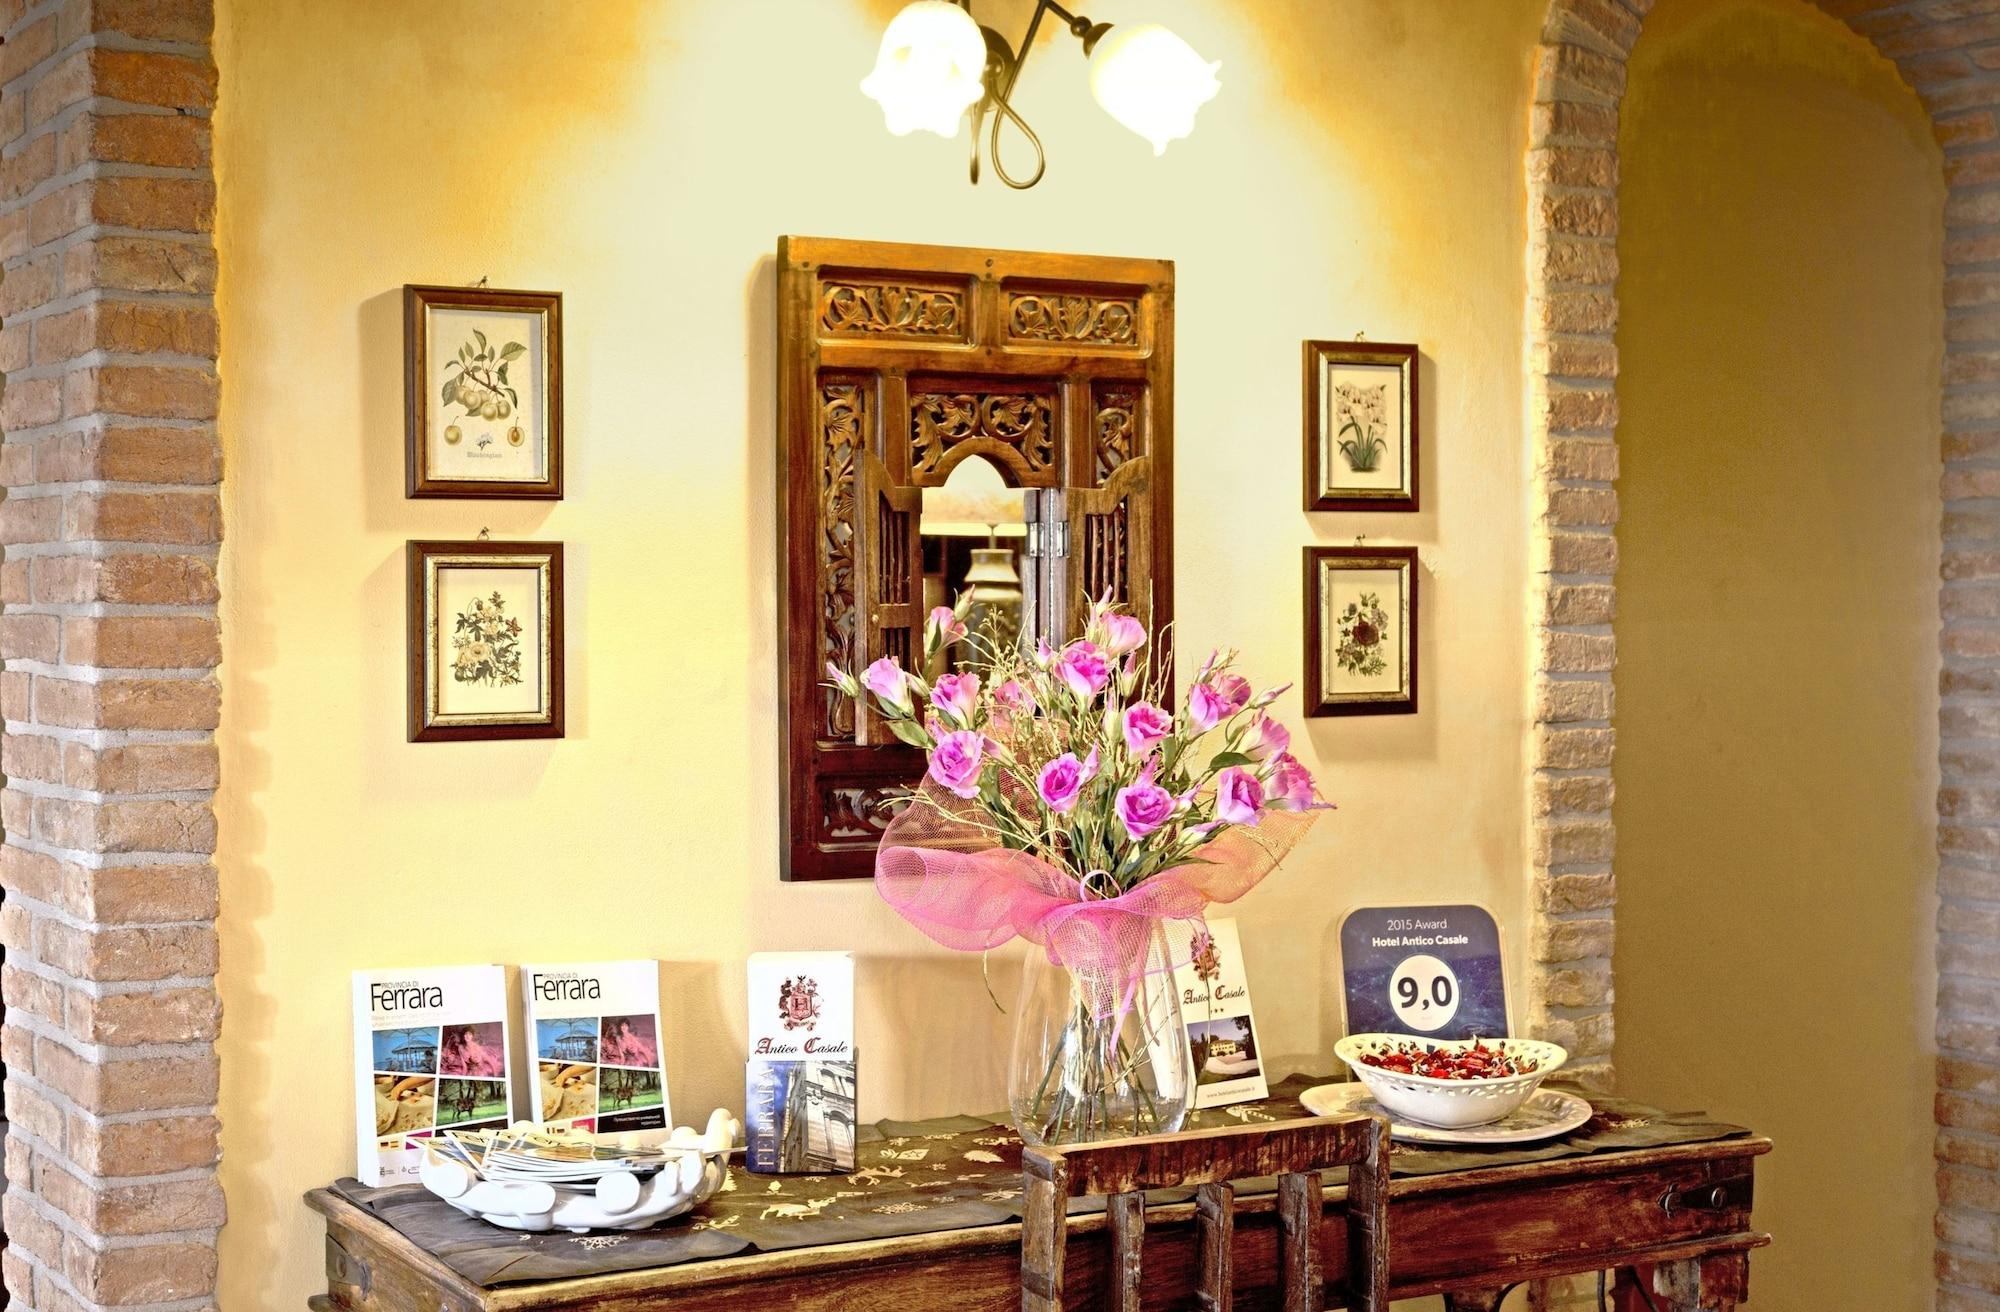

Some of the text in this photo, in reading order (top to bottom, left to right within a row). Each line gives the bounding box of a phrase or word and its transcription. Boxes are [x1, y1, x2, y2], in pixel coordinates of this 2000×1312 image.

[1387, 918, 1448, 931] 2015 Award
[1372, 934, 1469, 947] Hotel Antico Casale
[543, 972, 572, 980] PROVINCIA
[381, 980, 420, 989] PROVINCIA DI
[533, 973, 601, 1001] Ferrara
[1215, 985, 1246, 1000] Casale
[371, 983, 443, 1011] Ferrara
[1397, 975, 1453, 1011] 9,0
[755, 1037, 849, 1055] Antico Casale
[757, 1068, 775, 1166] FERRARA
